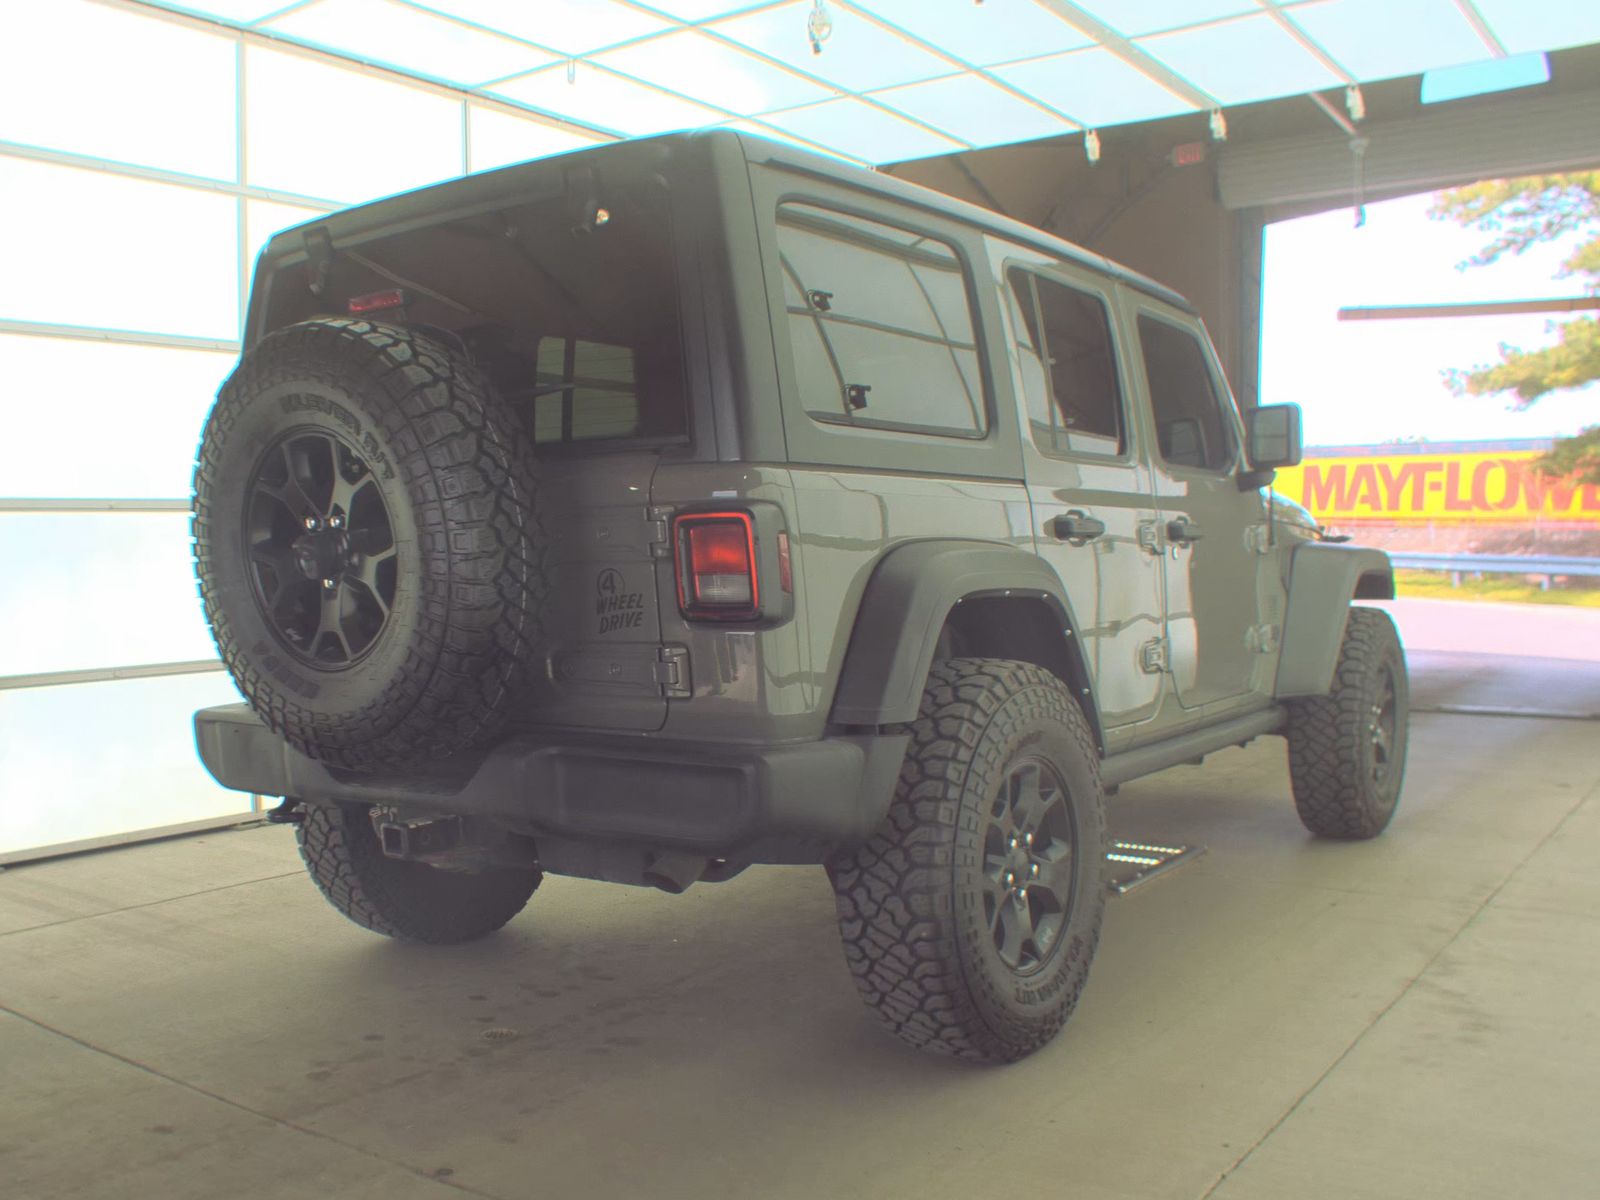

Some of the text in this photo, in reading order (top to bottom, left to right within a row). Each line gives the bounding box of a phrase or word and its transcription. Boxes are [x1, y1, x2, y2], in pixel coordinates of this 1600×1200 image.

[601, 572, 616, 594] 4
[596, 593, 644, 616] WHEEL
[598, 611, 643, 635] DRIVE
